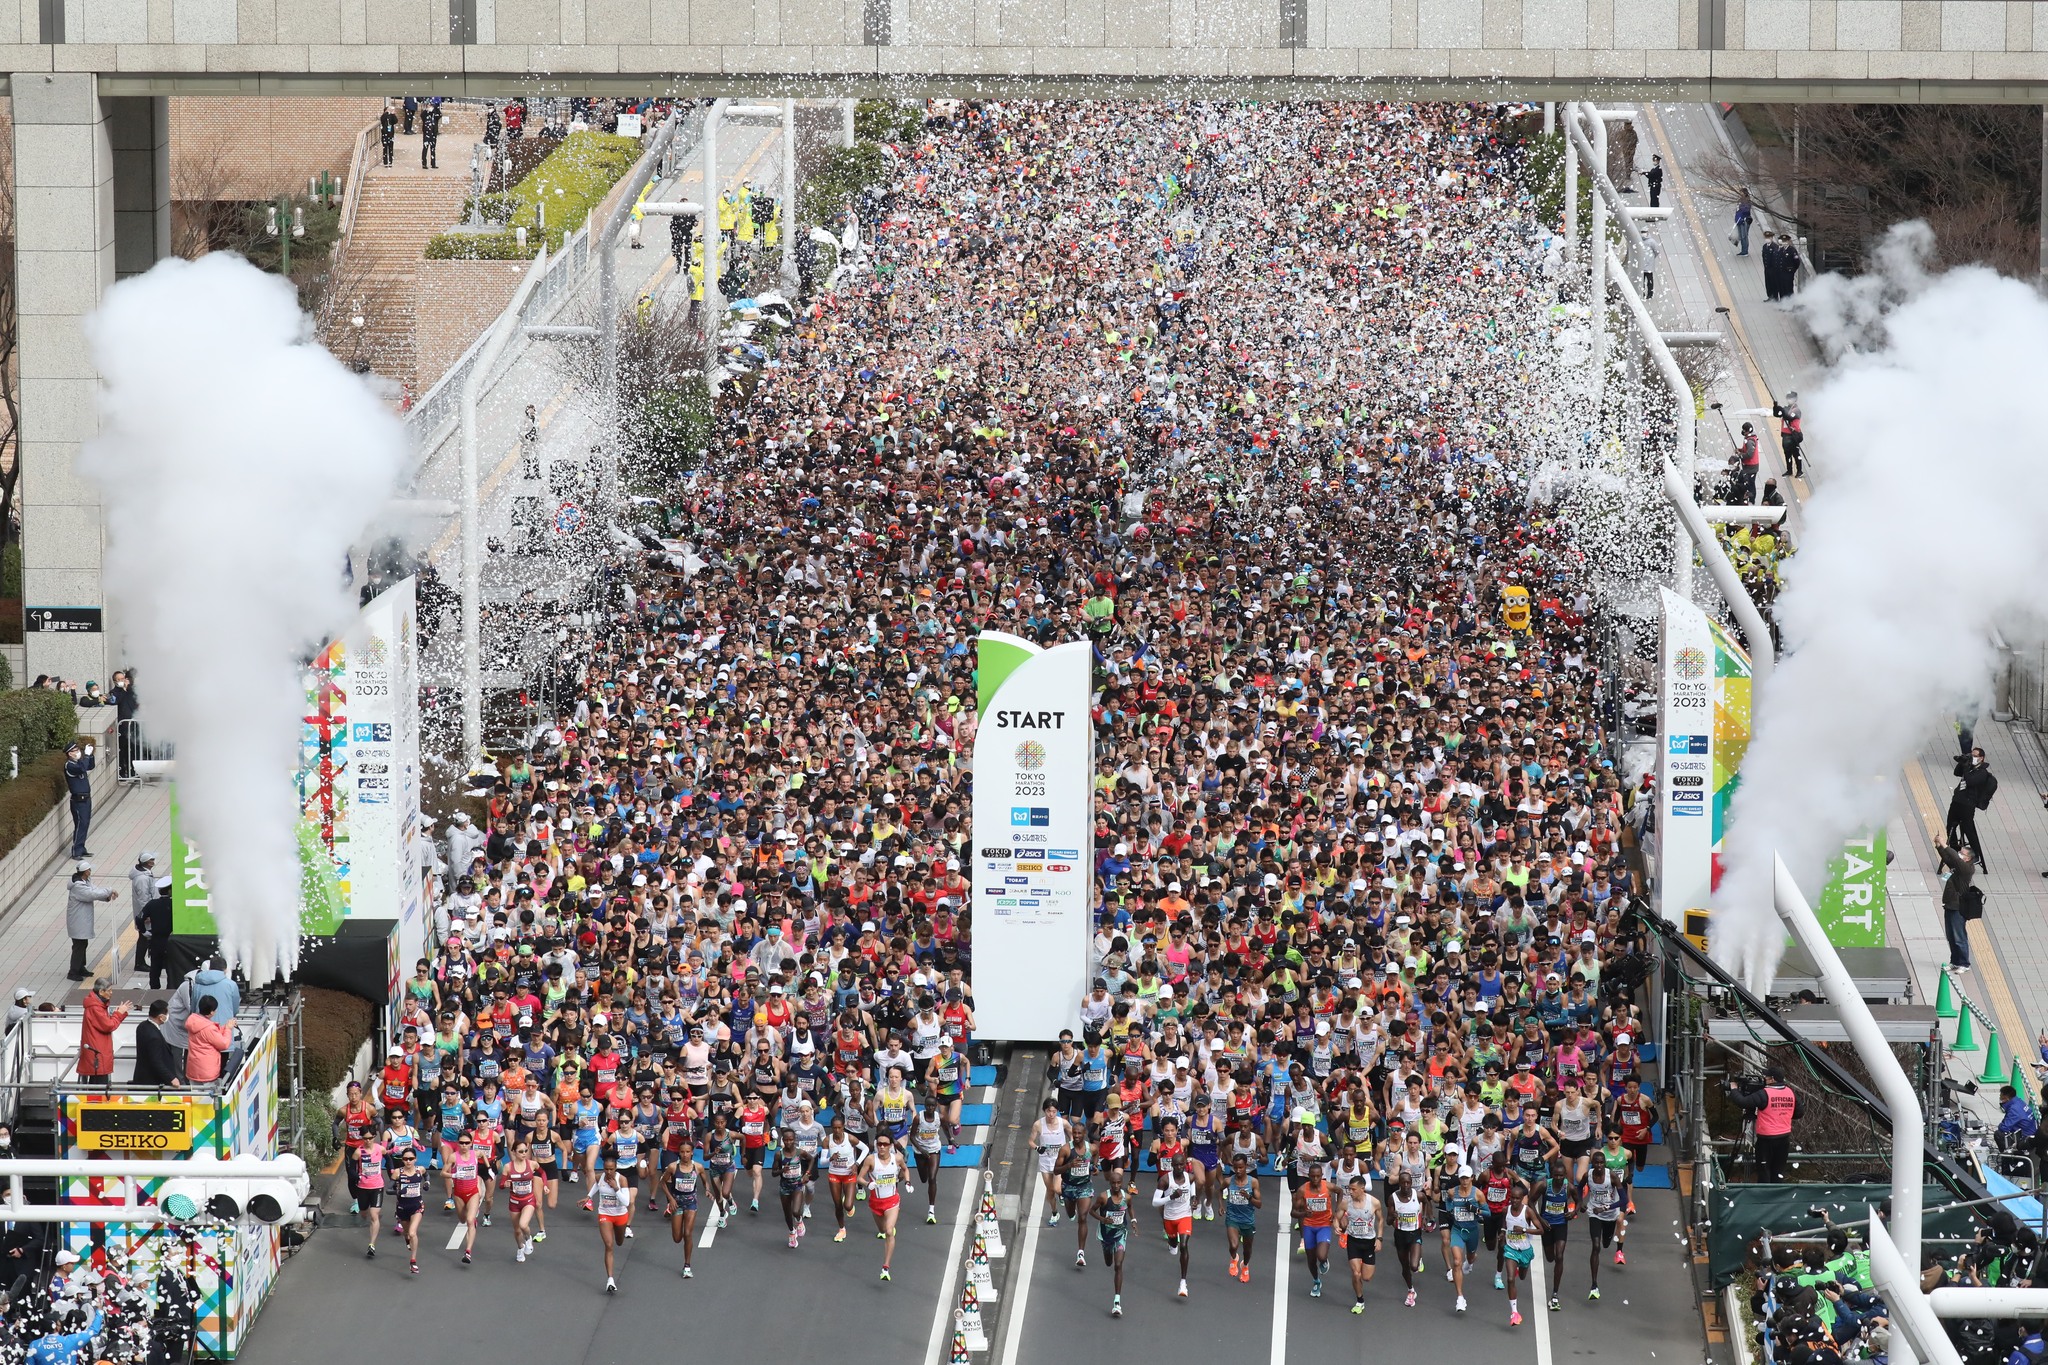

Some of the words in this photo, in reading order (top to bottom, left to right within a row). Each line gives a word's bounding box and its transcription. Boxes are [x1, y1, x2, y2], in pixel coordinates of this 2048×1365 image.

[355, 686, 388, 695] 2023
[1673, 697, 1706, 707] 2023
[997, 710, 1065, 729] START
[1015, 786, 1045, 796] 2023
[99, 1134, 168, 1148] SEIKO
